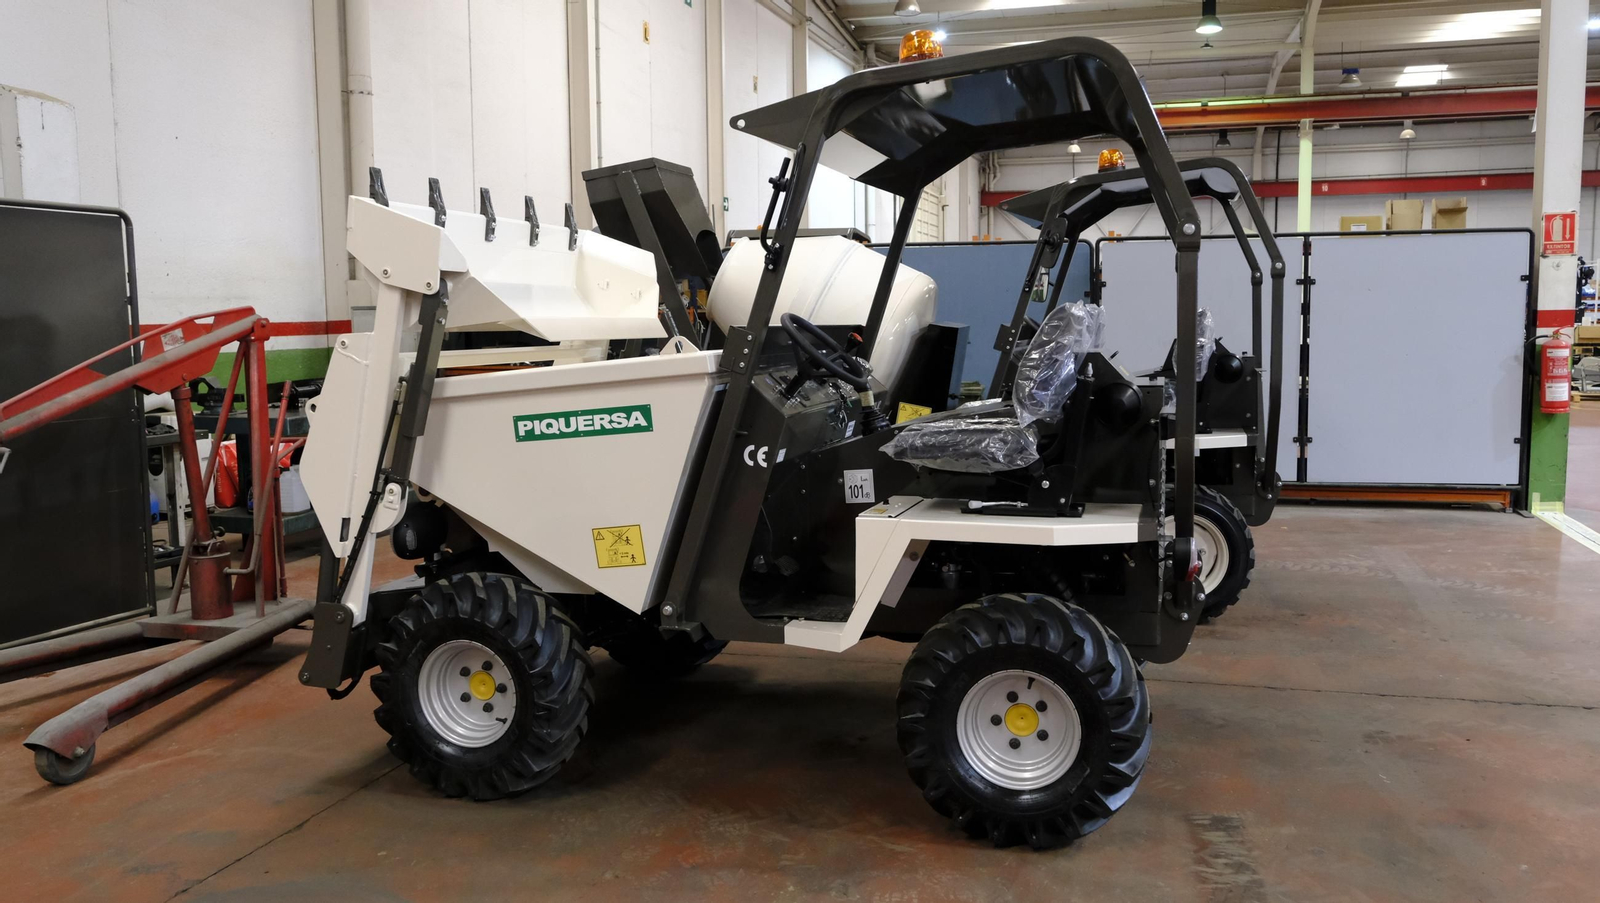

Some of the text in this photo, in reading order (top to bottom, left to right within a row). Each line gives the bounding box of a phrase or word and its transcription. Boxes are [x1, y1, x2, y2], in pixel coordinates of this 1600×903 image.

[517, 411, 648, 436] PIQUERSA
[743, 444, 768, 468] CE
[848, 484, 864, 499] 101
